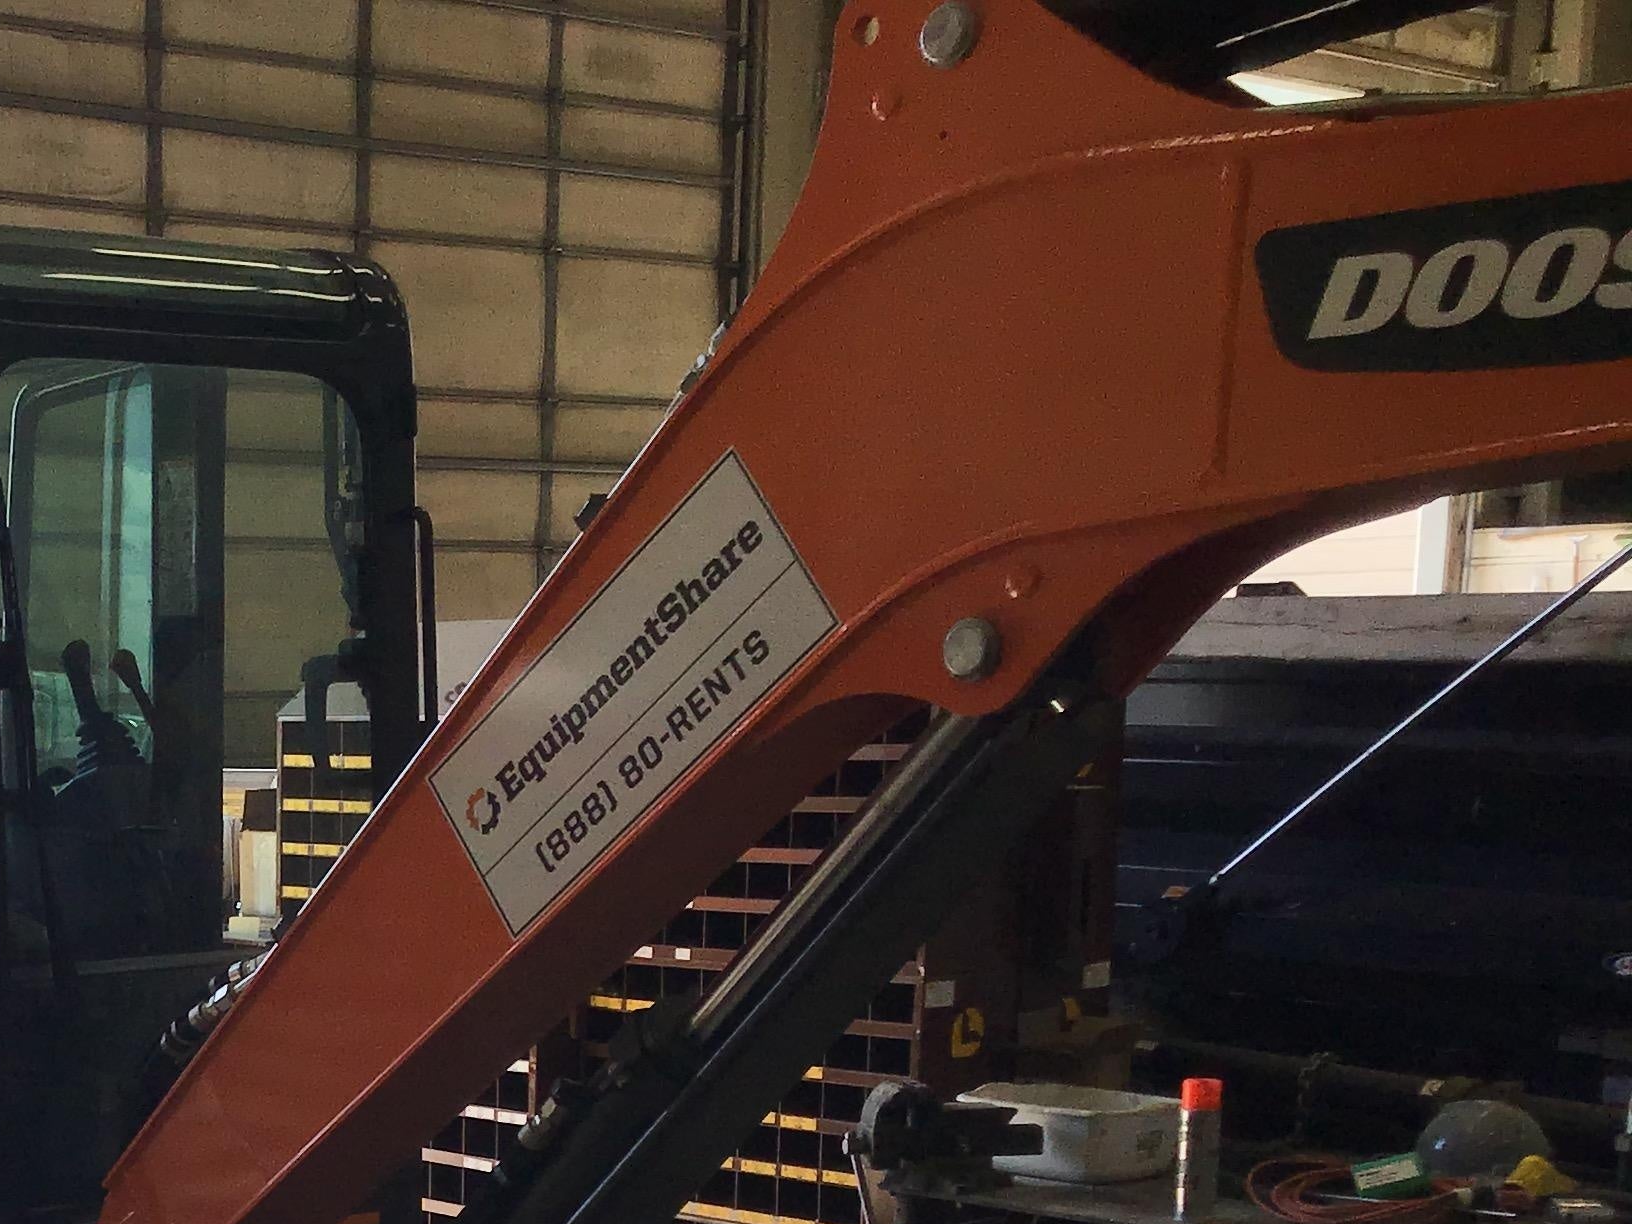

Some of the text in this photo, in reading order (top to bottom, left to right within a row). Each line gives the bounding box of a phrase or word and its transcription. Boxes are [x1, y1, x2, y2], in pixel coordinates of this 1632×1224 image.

[494, 518, 765, 803] EquipmentShare
[535, 629, 771, 874] (888) 80-RENTS
